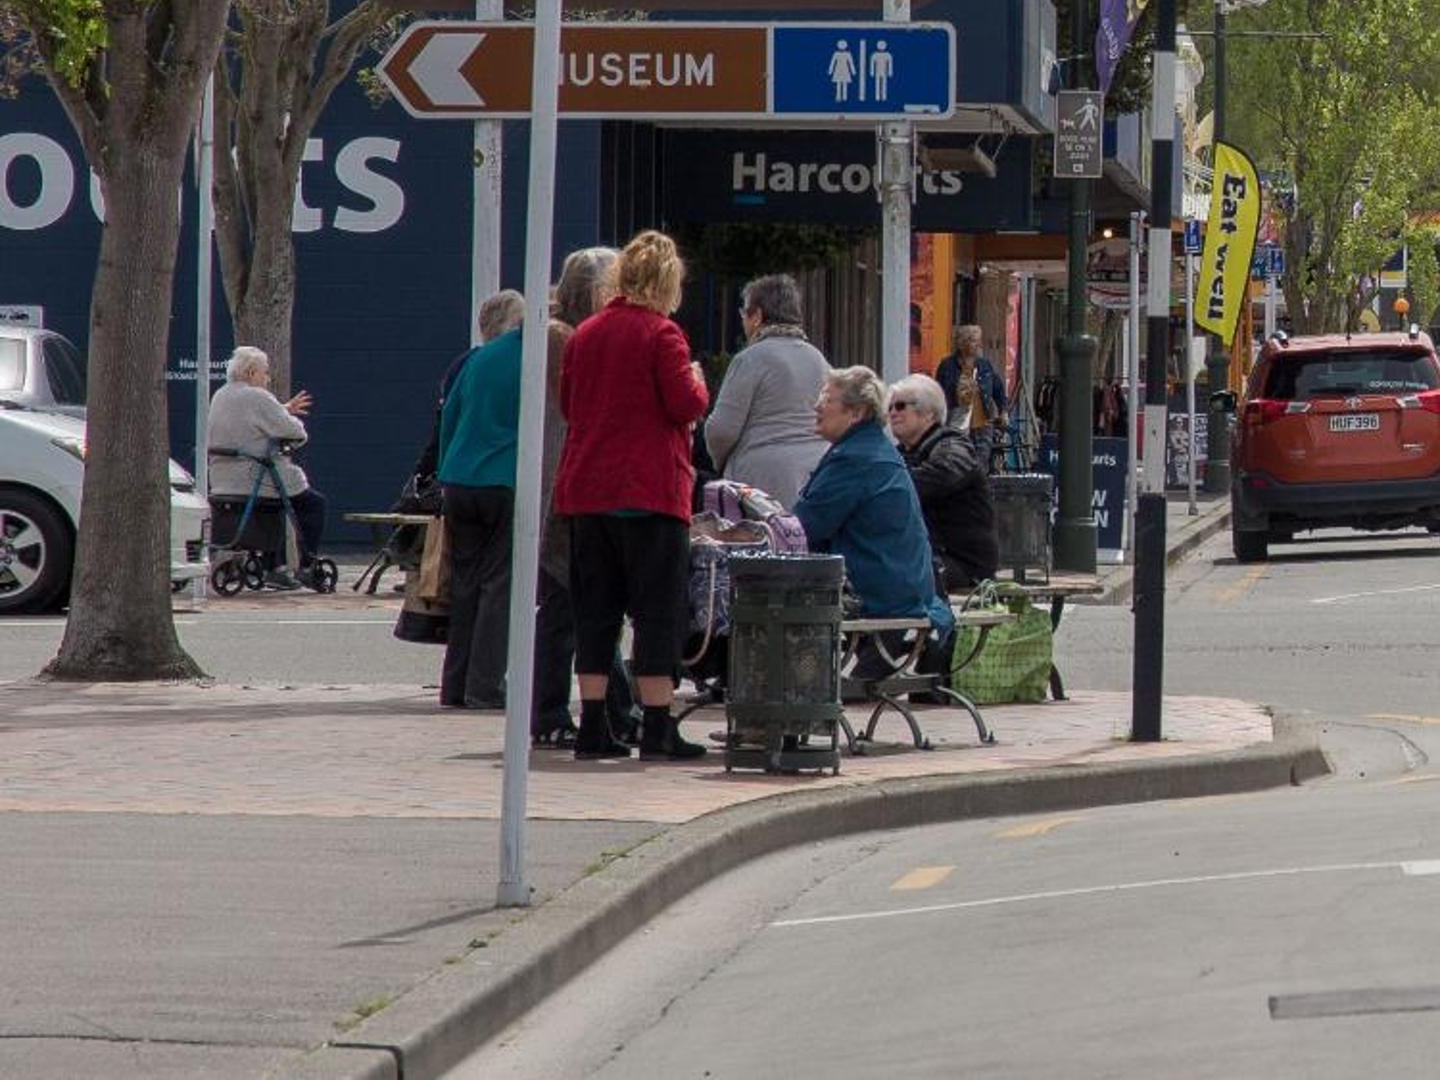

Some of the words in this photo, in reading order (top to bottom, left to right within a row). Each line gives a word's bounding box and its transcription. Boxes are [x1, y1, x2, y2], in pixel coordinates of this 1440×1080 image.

[562, 52, 715, 86] USEUM
[732, 152, 963, 194] Harcots
[1221, 174, 1247, 233] Eat
[1208, 244, 1228, 319] well
